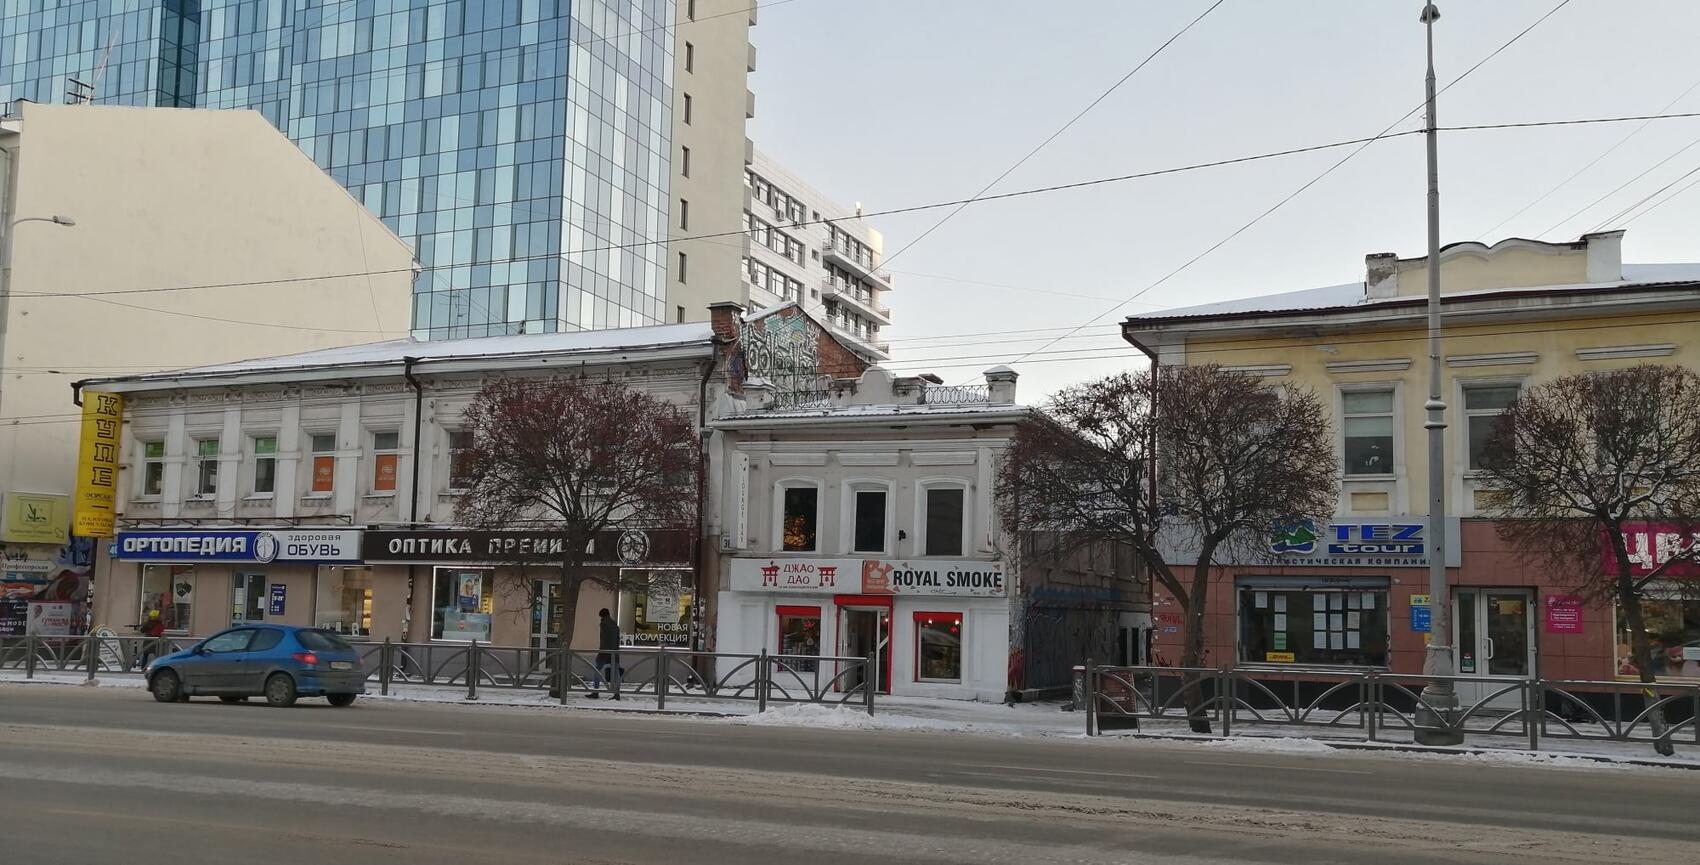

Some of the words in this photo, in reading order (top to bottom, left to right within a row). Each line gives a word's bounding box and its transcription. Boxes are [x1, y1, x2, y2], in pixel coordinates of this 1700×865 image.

[92, 395, 118, 487] КУПЕ
[288, 534, 341, 542] здоровая
[1329, 525, 1424, 541] TEZ
[123, 537, 247, 556] ОРТОПЕДИЯ
[288, 544, 341, 557] ОБУВЬ
[388, 538, 472, 554] ОПТИКА
[1335, 544, 1417, 553] tour
[783, 563, 815, 574] ДЖАО
[787, 575, 811, 585] ДАО
[893, 570, 942, 587] ROYAL
[946, 571, 1003, 588] SMOKE
[657, 623, 688, 632] НОВАЯ
[634, 633, 688, 643] КОЛЛЕКЦИЯ
